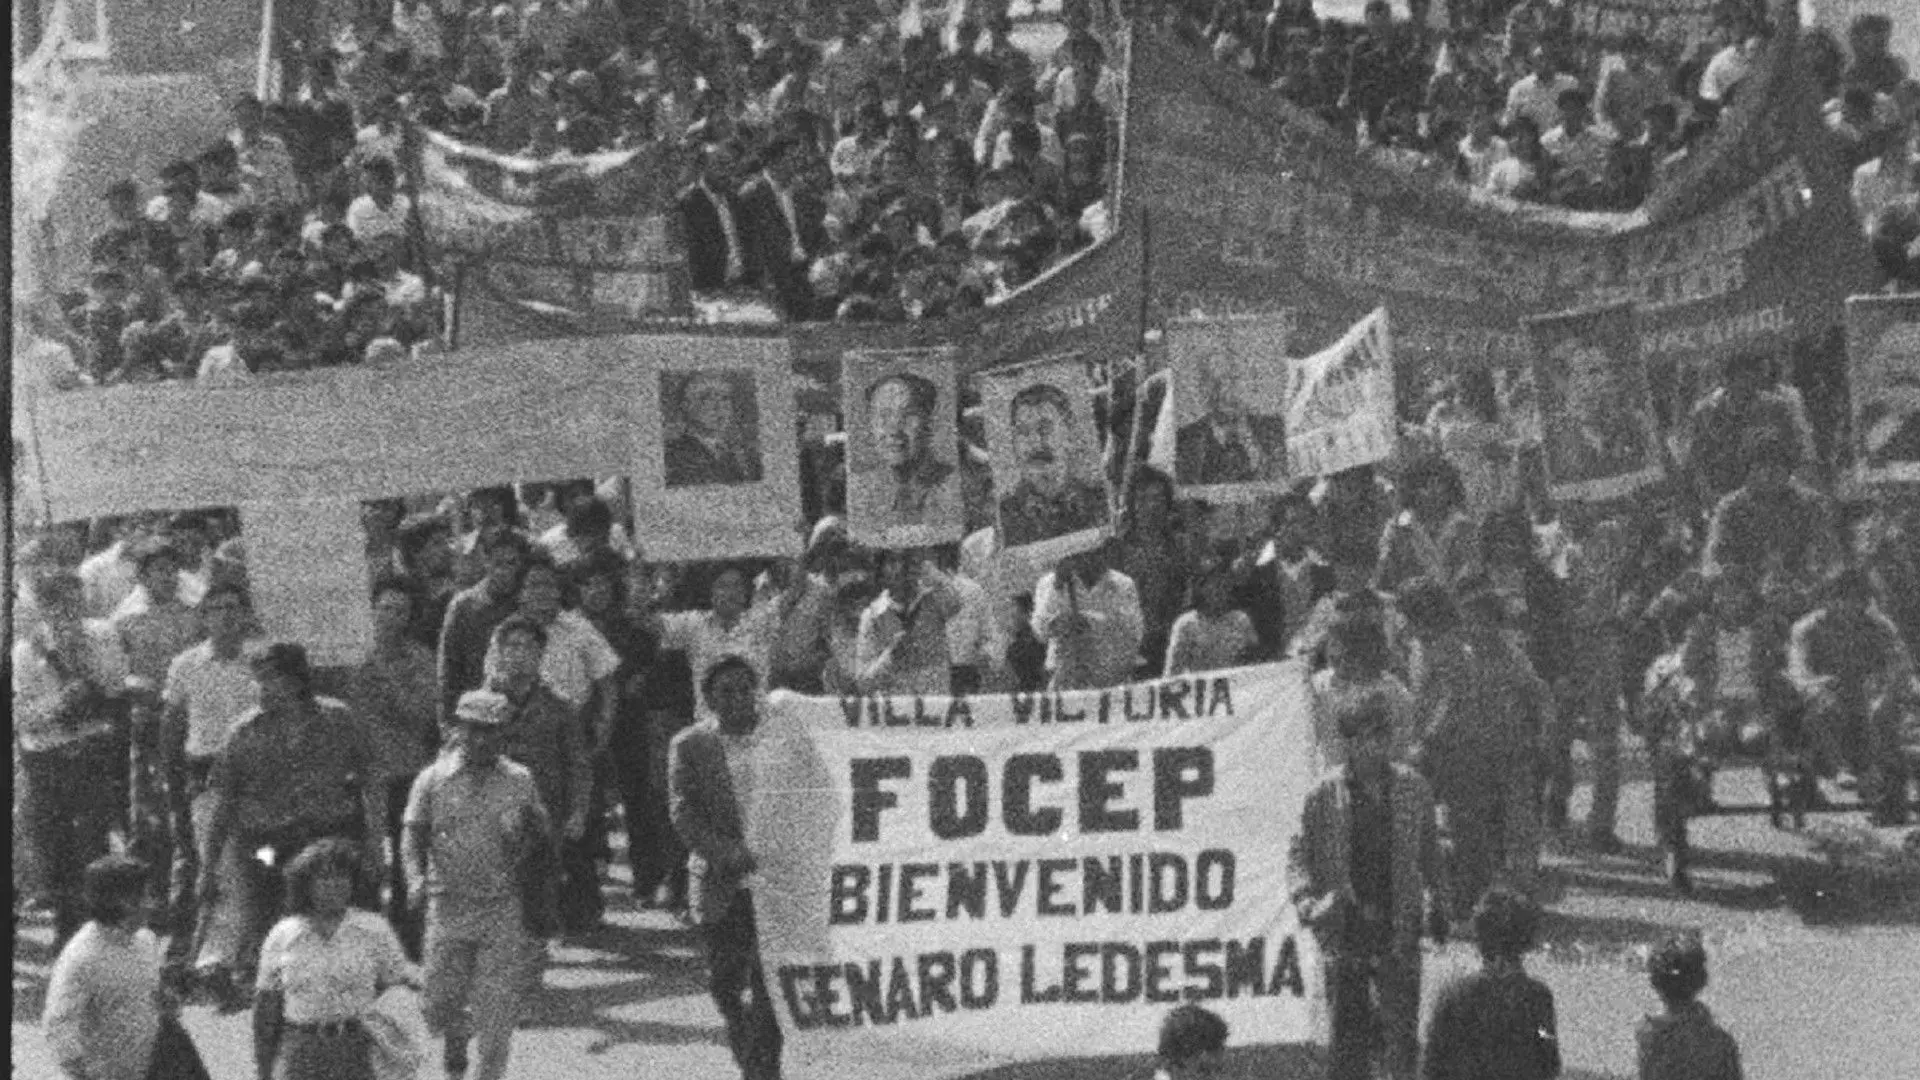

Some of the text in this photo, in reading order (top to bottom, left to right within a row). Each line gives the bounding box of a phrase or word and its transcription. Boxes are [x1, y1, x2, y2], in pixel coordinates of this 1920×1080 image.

[841, 693, 974, 728] VILLA
[849, 745, 1214, 844] FOCEP
[828, 848, 1236, 926] BIENVENIDO
[777, 933, 1306, 1031] GENARO LEDESMA
